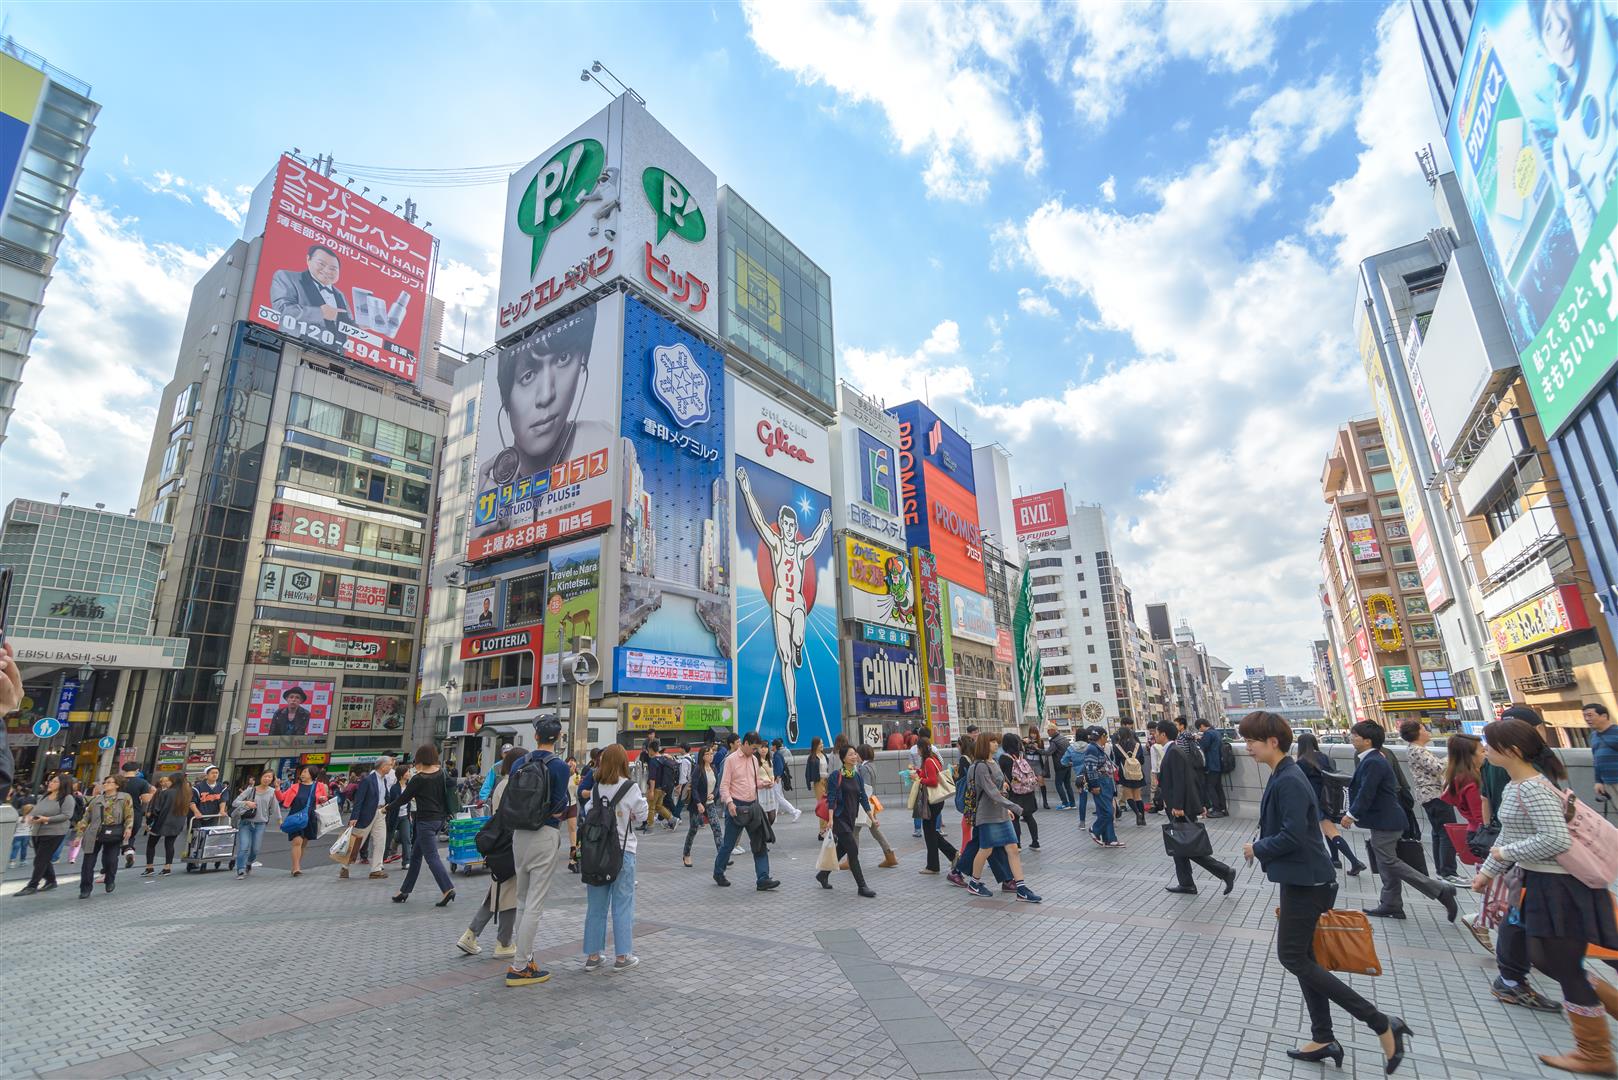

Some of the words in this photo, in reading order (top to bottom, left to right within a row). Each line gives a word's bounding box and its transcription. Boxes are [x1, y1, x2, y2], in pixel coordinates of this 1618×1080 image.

[285, 161, 371, 215] スーパー
[279, 199, 333, 233] SUPER
[336, 228, 389, 261] MILLION
[392, 255, 426, 278] HAIR
[282, 181, 427, 261] ミリオンヘアー
[644, 240, 710, 313] ピップ
[282, 314, 415, 377] 0120-494-111
[341, 325, 369, 339] ルアン
[1541, 317, 1606, 403] きもちいい。
[643, 417, 719, 461] 雪印メグミルク
[756, 420, 815, 464] Glico
[478, 453, 607, 522] サタデープラス
[498, 496, 544, 519] SATURDAY
[547, 488, 571, 505] PLUS
[935, 500, 982, 548] PROMISE
[1020, 503, 1052, 526] B.V.D.
[1026, 530, 1057, 540] FUJIBO
[482, 522, 548, 555] 土曜あさ8時
[550, 568, 573, 580] Travel
[579, 564, 597, 574] Nara
[557, 578, 590, 591] Kintetsu.
[782, 557, 796, 603] グリコ
[17, 649, 54, 660] EBISU
[55, 652, 117, 664] BASHI-SUJI
[482, 634, 527, 651] LOTTERIA
[862, 650, 920, 697] CHINTAI
